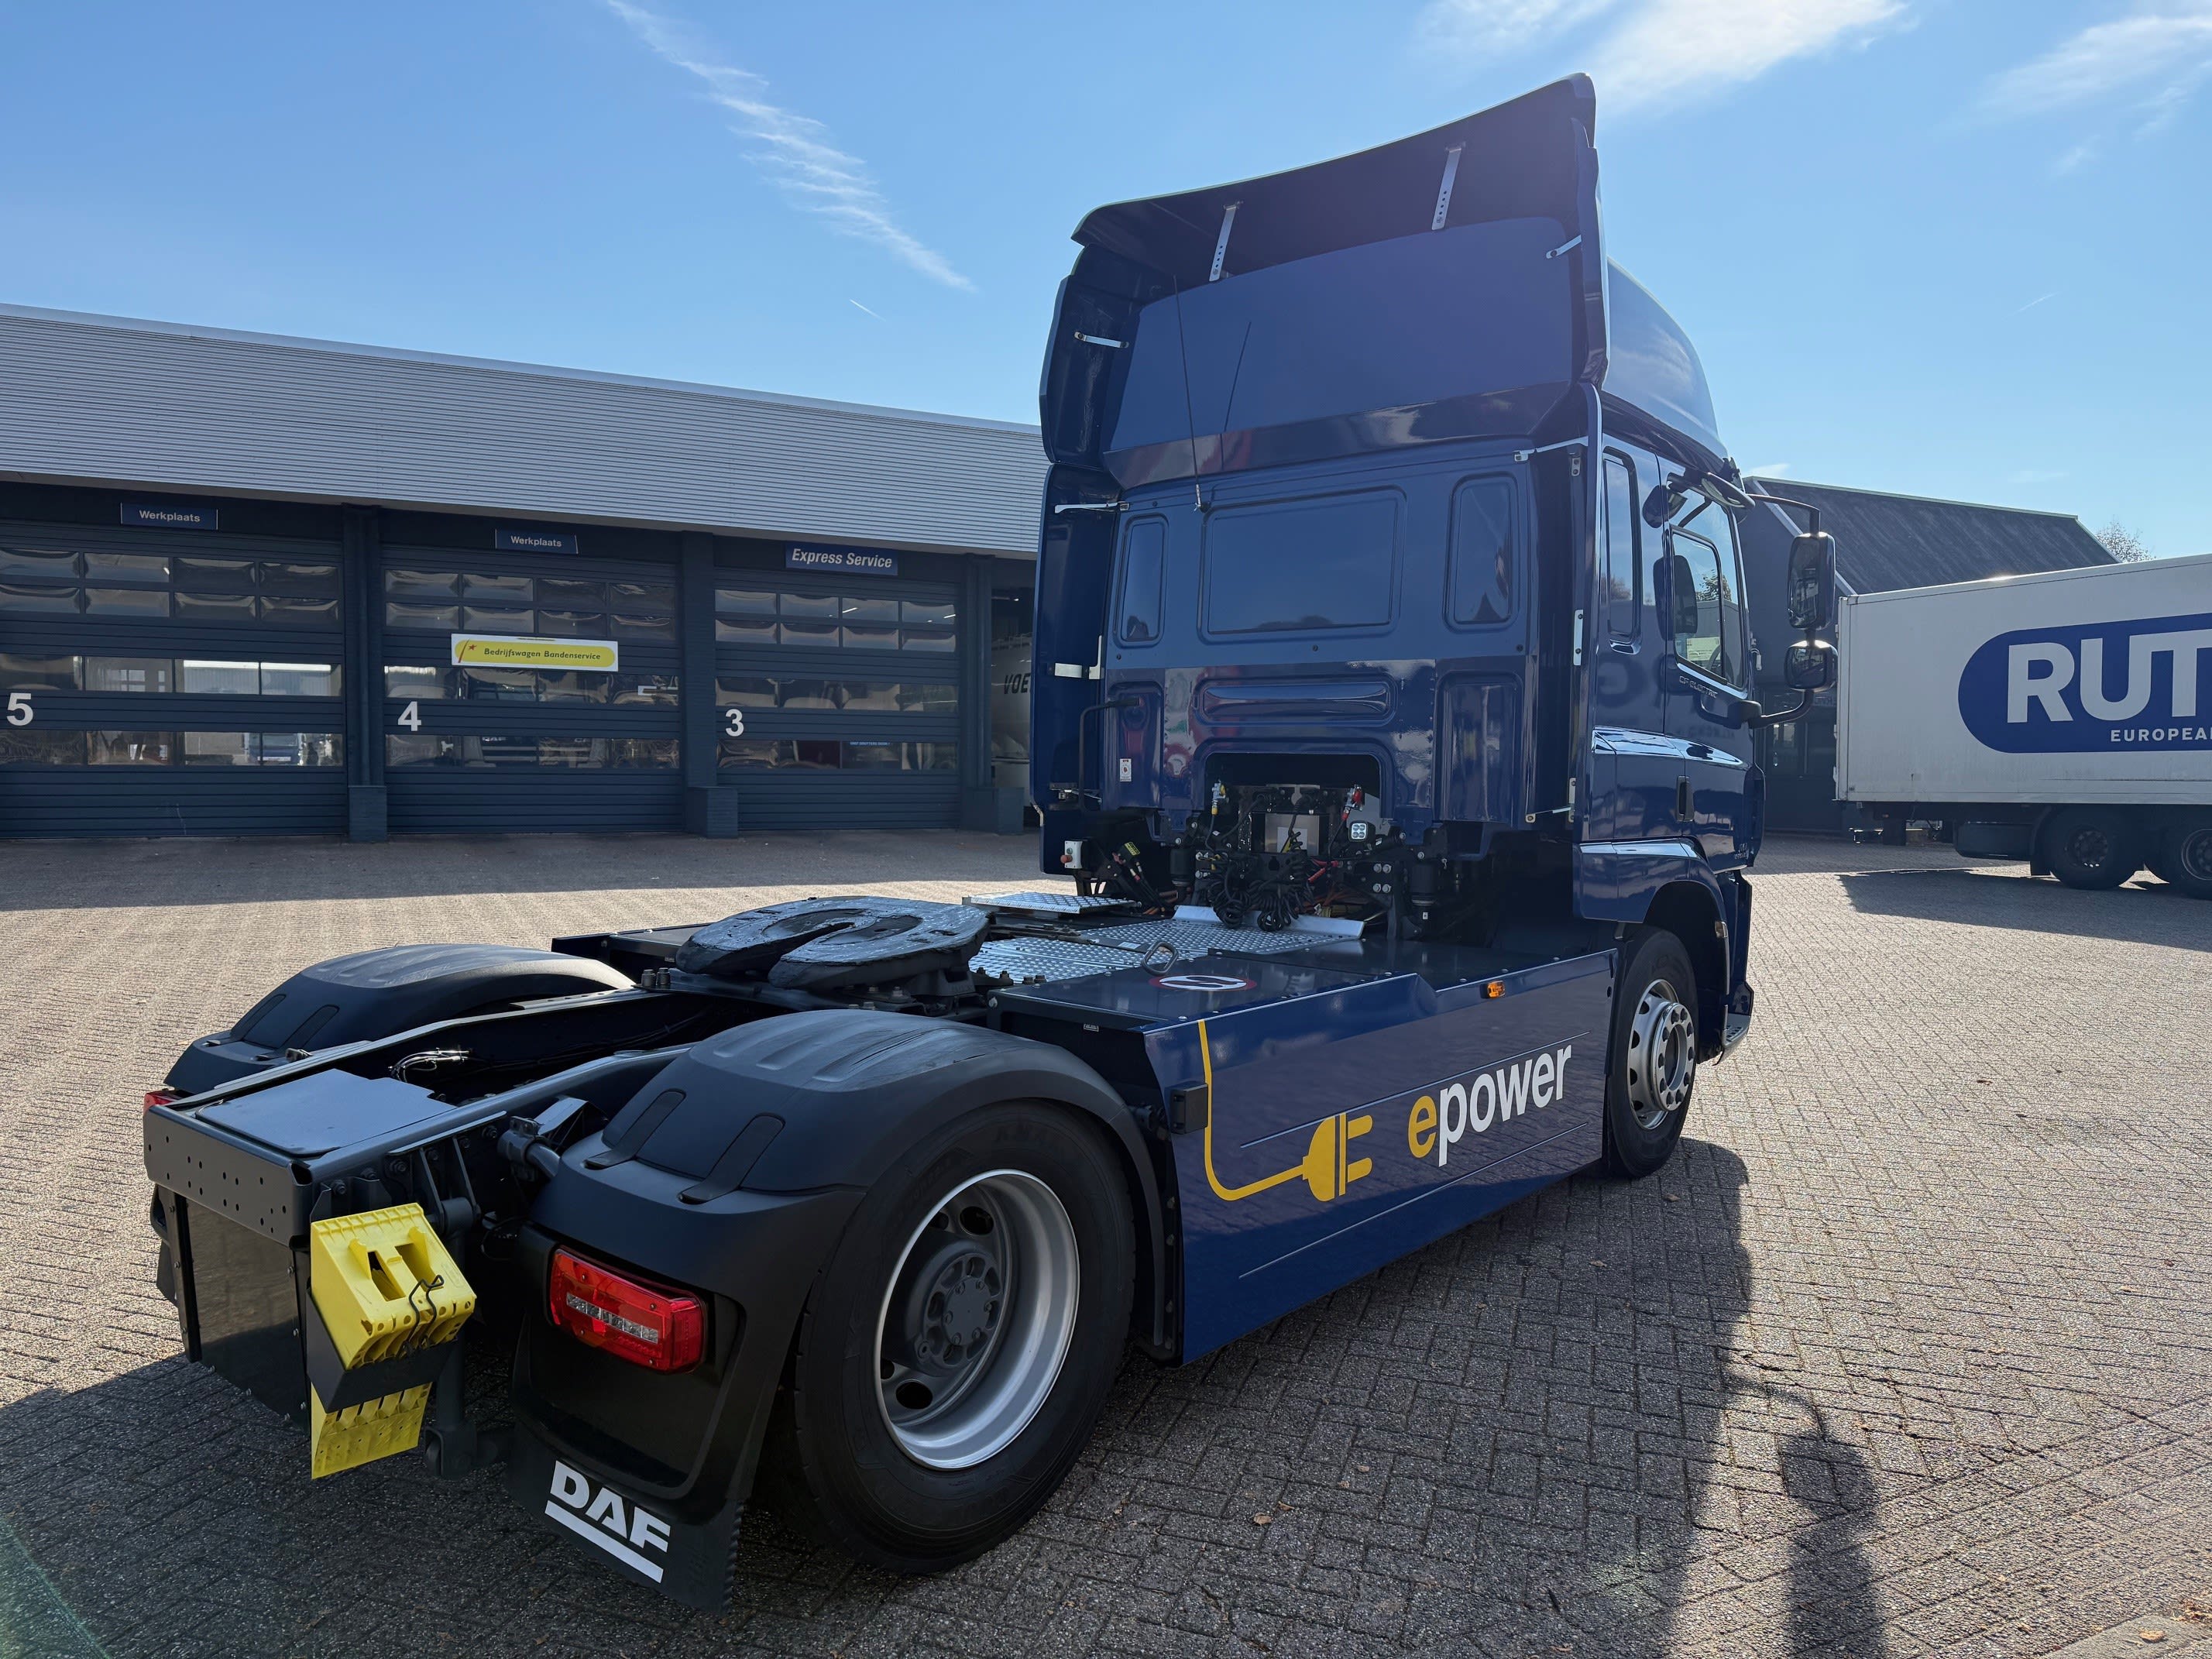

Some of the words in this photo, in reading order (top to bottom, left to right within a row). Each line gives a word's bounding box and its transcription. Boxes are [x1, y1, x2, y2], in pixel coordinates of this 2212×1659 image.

[139, 510, 201, 522] Werkplaats
[510, 536, 562, 547] Werkplaats
[792, 548, 843, 565] Express
[846, 552, 892, 568] Service
[484, 647, 541, 658] Bedrijfswagen
[544, 651, 601, 660] Bandenservice
[6, 692, 33, 726] 5
[398, 701, 421, 731] 4
[725, 709, 744, 737] 3
[2111, 726, 2212, 742] EUROPEA
[1408, 1045, 1571, 1167] epower
[550, 1460, 671, 1553] DAF
